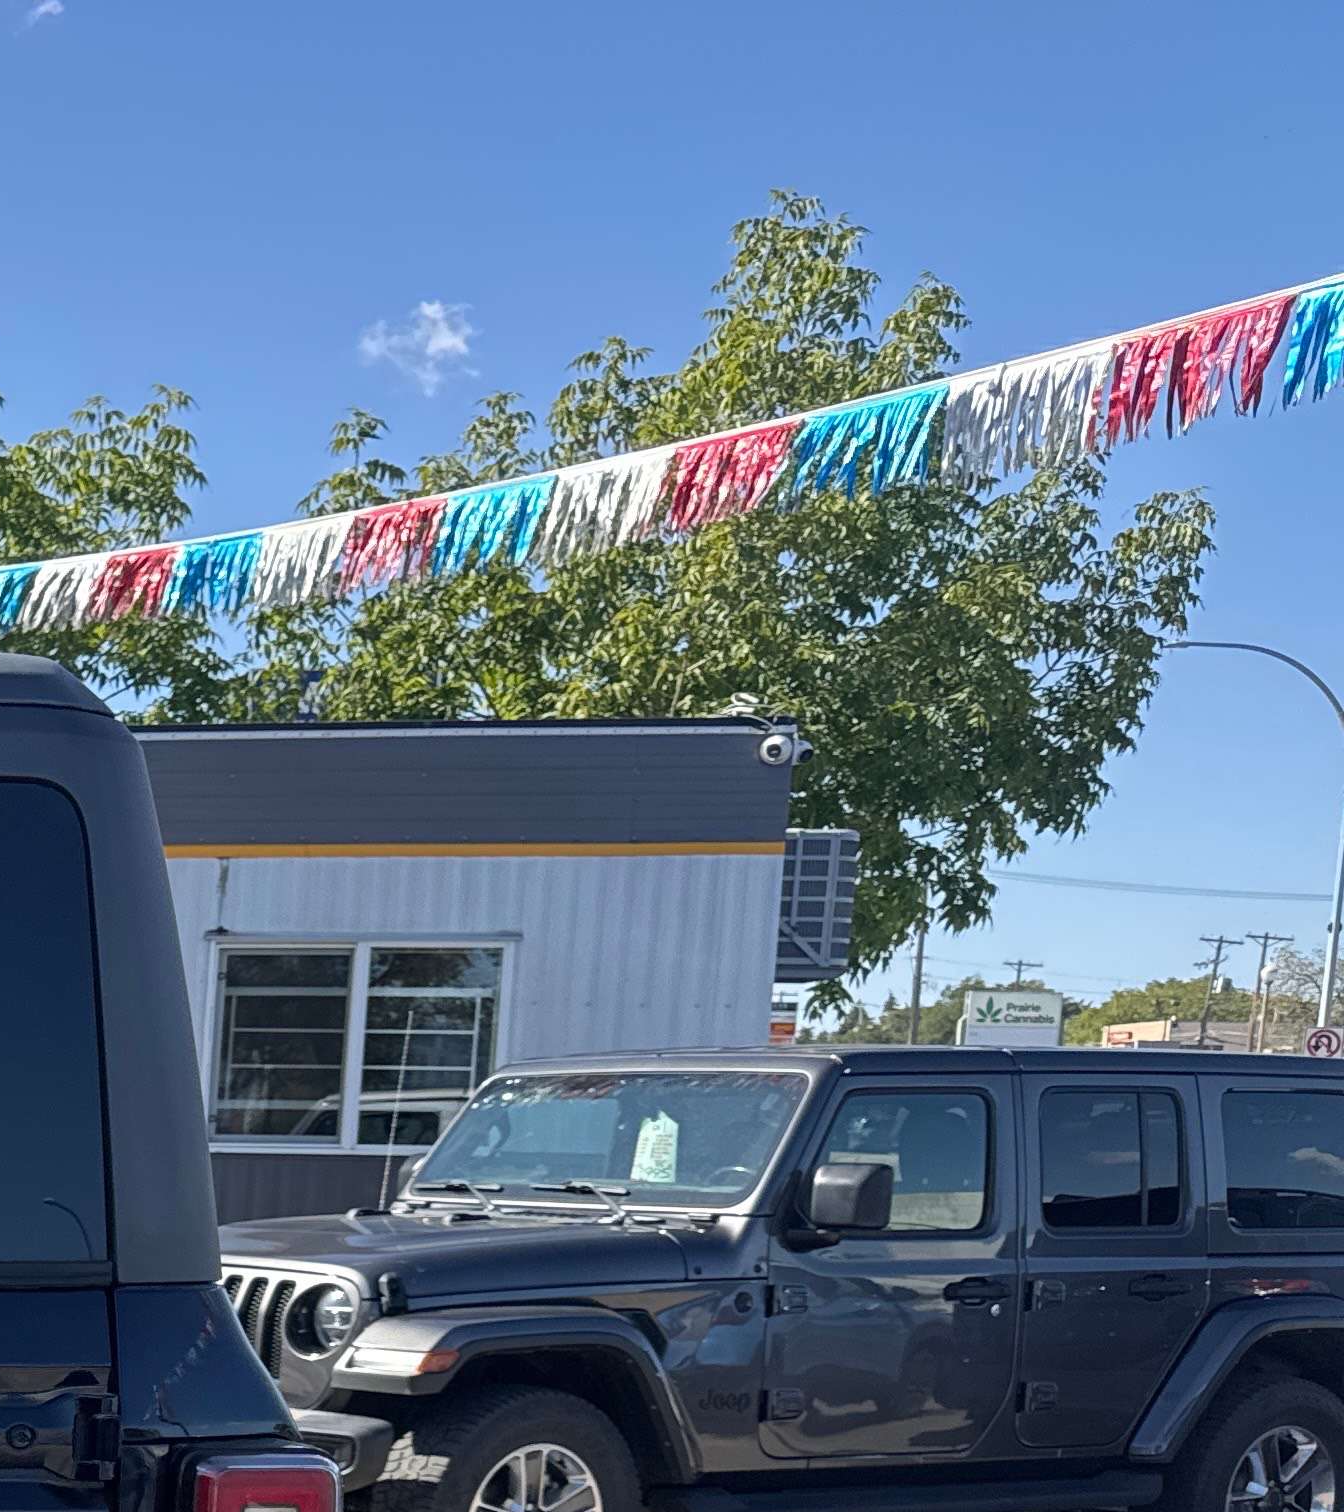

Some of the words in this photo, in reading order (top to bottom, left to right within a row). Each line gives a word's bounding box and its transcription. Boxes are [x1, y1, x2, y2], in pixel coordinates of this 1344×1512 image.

[1005, 1002, 1041, 1012] Prairie
[1004, 1013, 1055, 1024] Cannabis
[698, 1388, 752, 1414] Jeep
